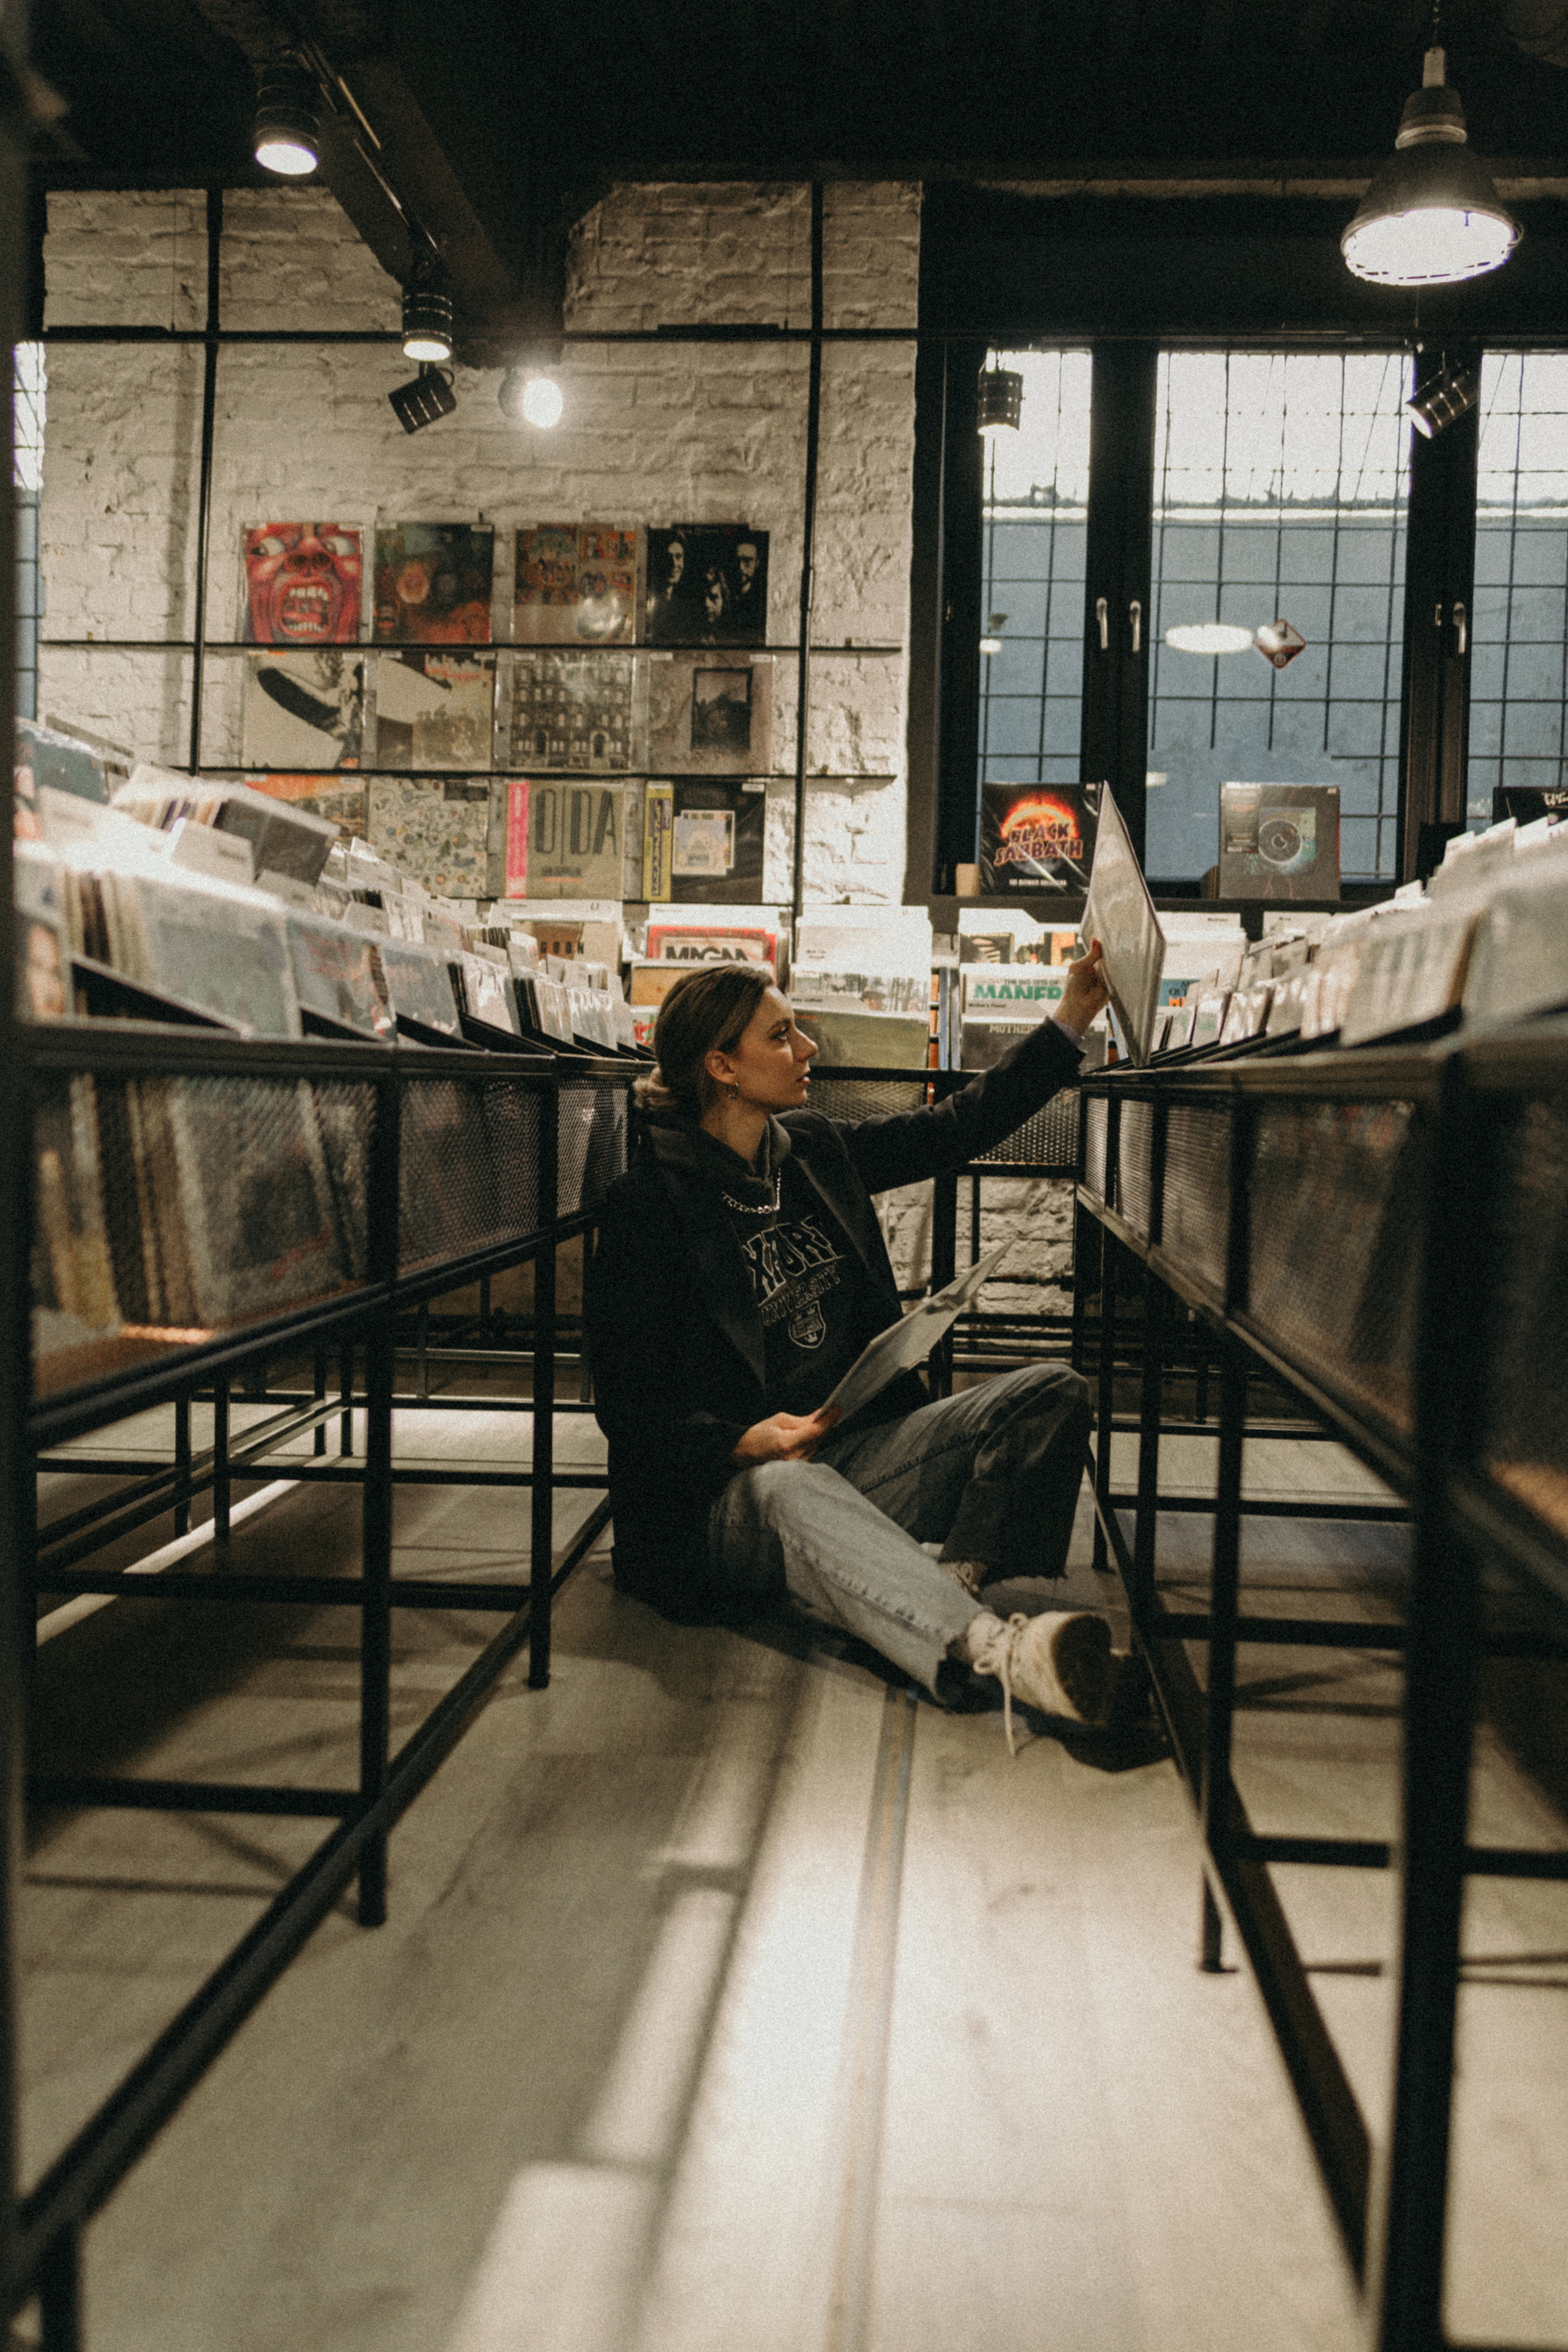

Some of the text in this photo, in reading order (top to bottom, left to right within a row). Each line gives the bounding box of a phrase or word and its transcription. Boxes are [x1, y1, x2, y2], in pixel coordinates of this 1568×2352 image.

[1009, 821, 1071, 843] BLACK
[993, 838, 1084, 866] SABBATH
[760, 1263, 841, 1327] UNIVERSITY
